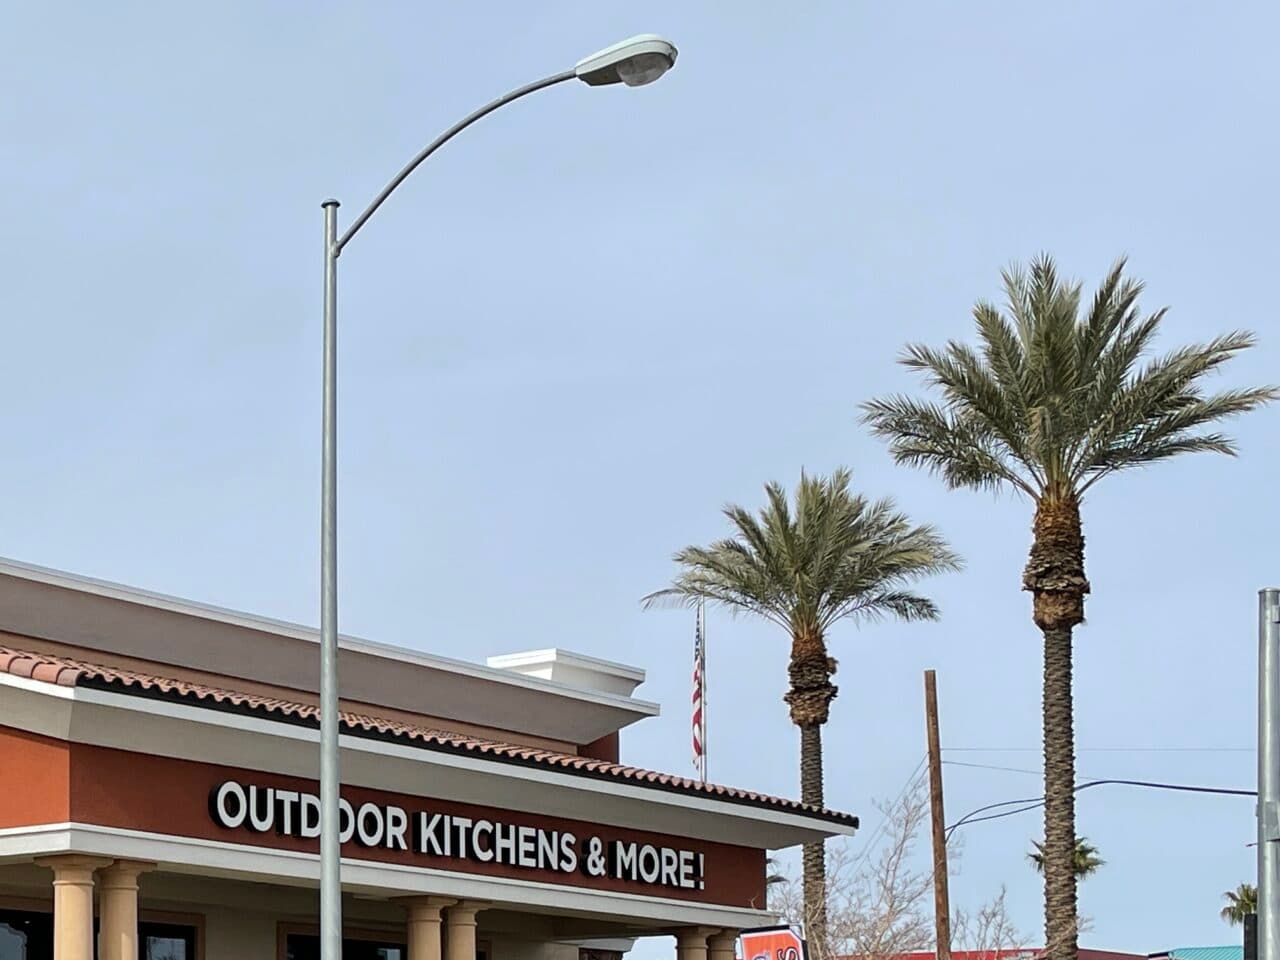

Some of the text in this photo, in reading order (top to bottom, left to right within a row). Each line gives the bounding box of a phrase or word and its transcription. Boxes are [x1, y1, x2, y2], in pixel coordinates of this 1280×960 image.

[420, 813, 577, 873] KITCHENS
[586, 836, 606, 877] &
[615, 840, 706, 890] MORE!
